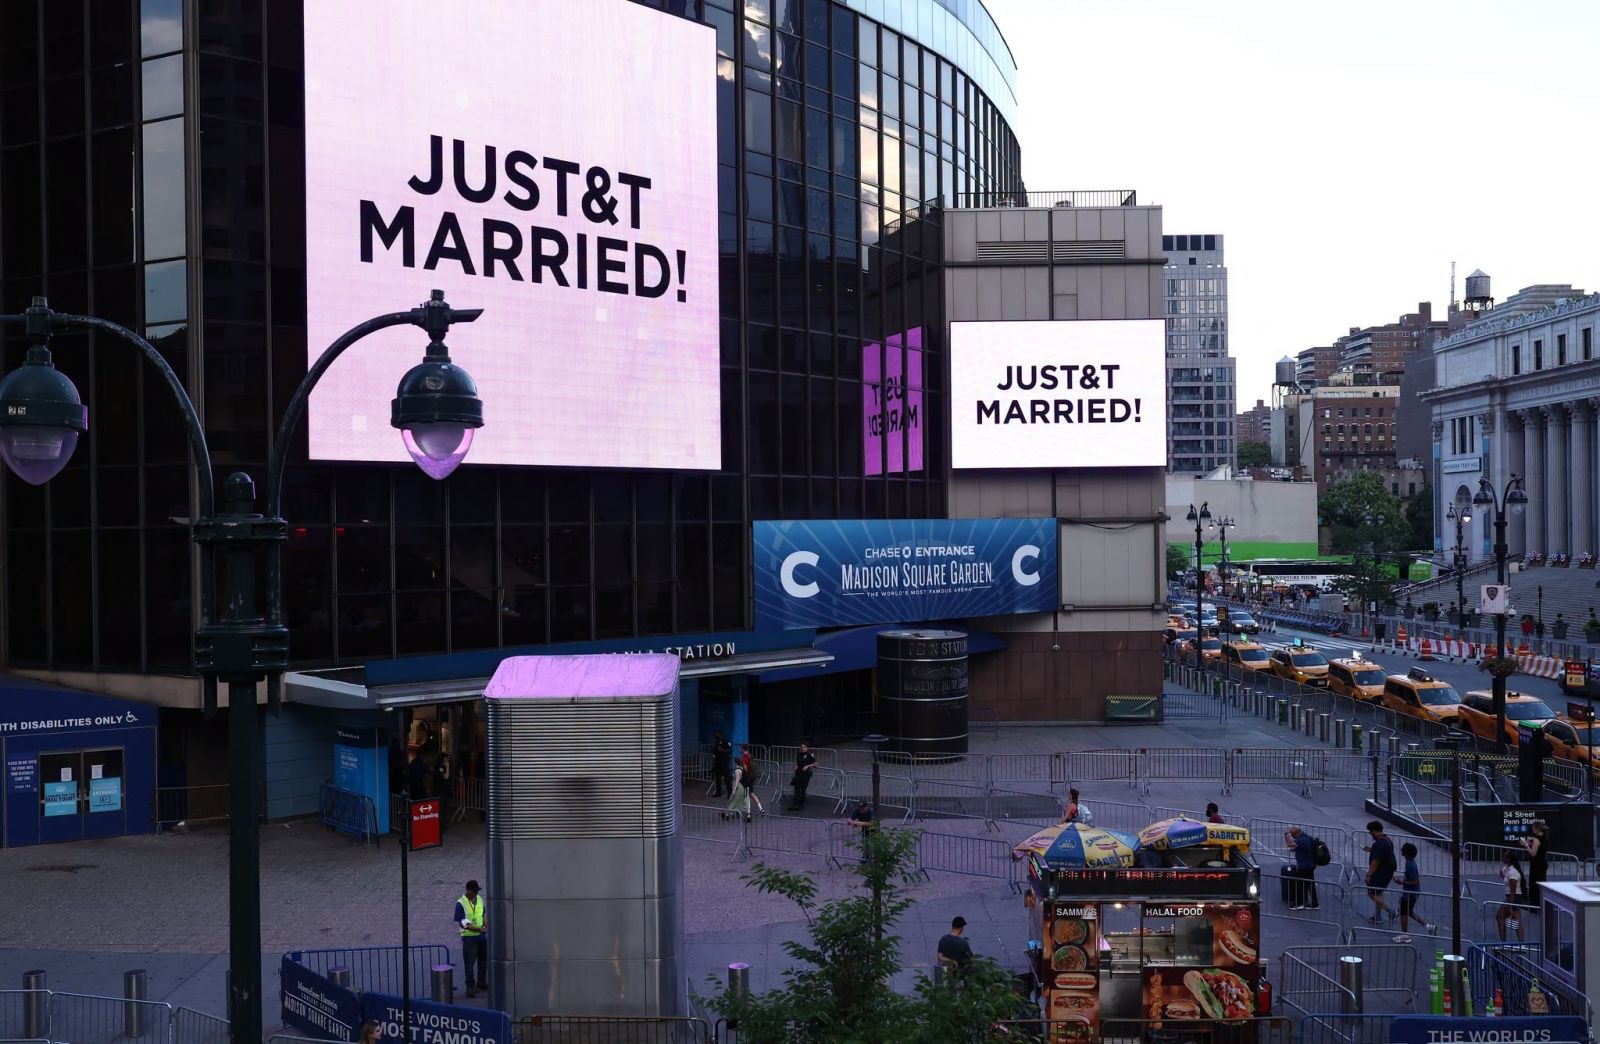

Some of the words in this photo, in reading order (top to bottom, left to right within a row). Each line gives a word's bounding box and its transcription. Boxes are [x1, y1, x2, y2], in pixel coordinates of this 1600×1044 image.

[407, 134, 652, 230] JUST&T
[359, 199, 688, 303] MARRIED!
[997, 364, 1120, 391] JUST&T
[976, 398, 1141, 424] MARRIED!
[864, 547, 901, 559] CHASE
[915, 545, 975, 557] ENTRANCE
[780, 550, 821, 598] C
[841, 563, 899, 590] MADISON
[902, 561, 947, 588] SQUARE
[950, 560, 993, 585] GARDEN
[1011, 544, 1041, 586] C
[20, 718, 92, 730] DISABILITIES
[94, 715, 123, 725] ONLY
[1208, 830, 1247, 841] SABRETT
[1056, 907, 1098, 917] SAMMY'S
[1145, 908, 1176, 917] HALAL
[1177, 907, 1204, 916] FOOD
[416, 1012, 481, 1034] WORLD'S
[1427, 1030, 1464, 1043] THE
[1469, 1029, 1551, 1043] WORLD'S
